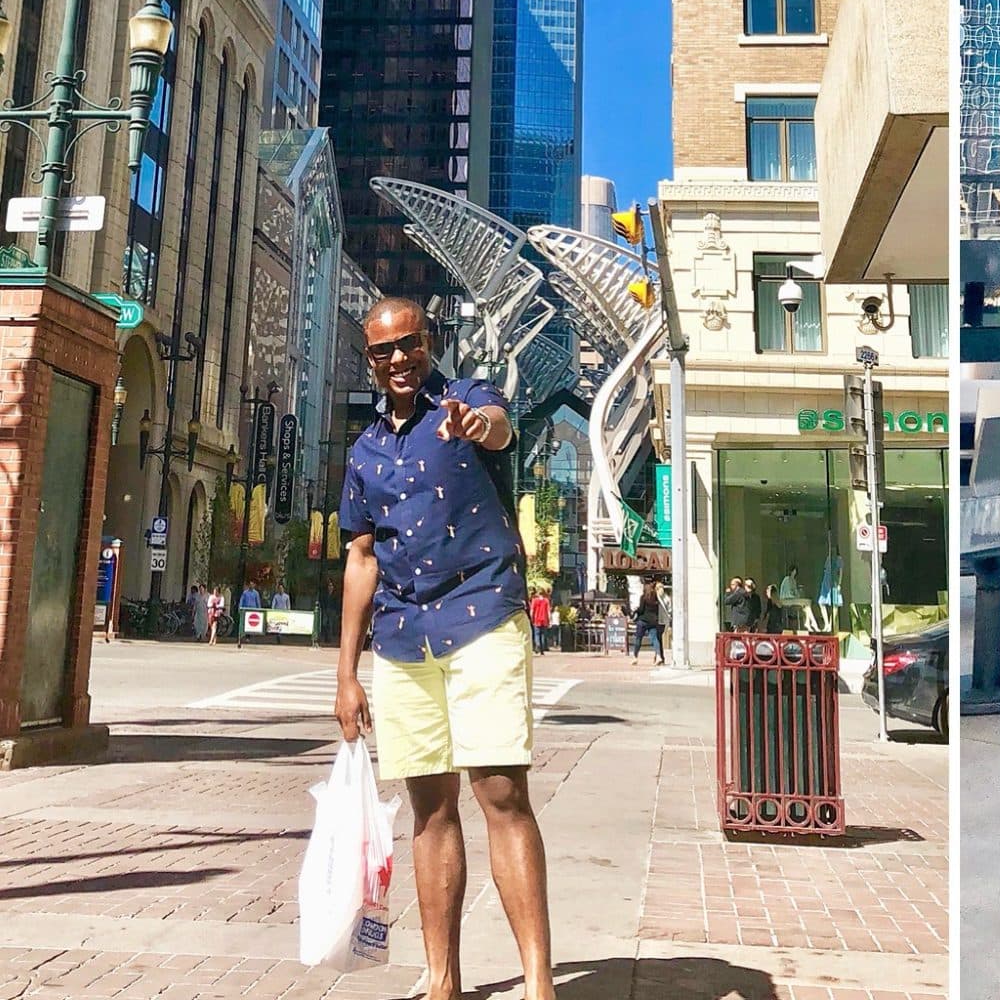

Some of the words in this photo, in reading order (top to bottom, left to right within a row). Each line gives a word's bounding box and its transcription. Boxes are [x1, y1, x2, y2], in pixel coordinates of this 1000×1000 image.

[281, 421, 295, 450] Shops
[279, 462, 292, 502] Services
[152, 559, 165, 569] 30
